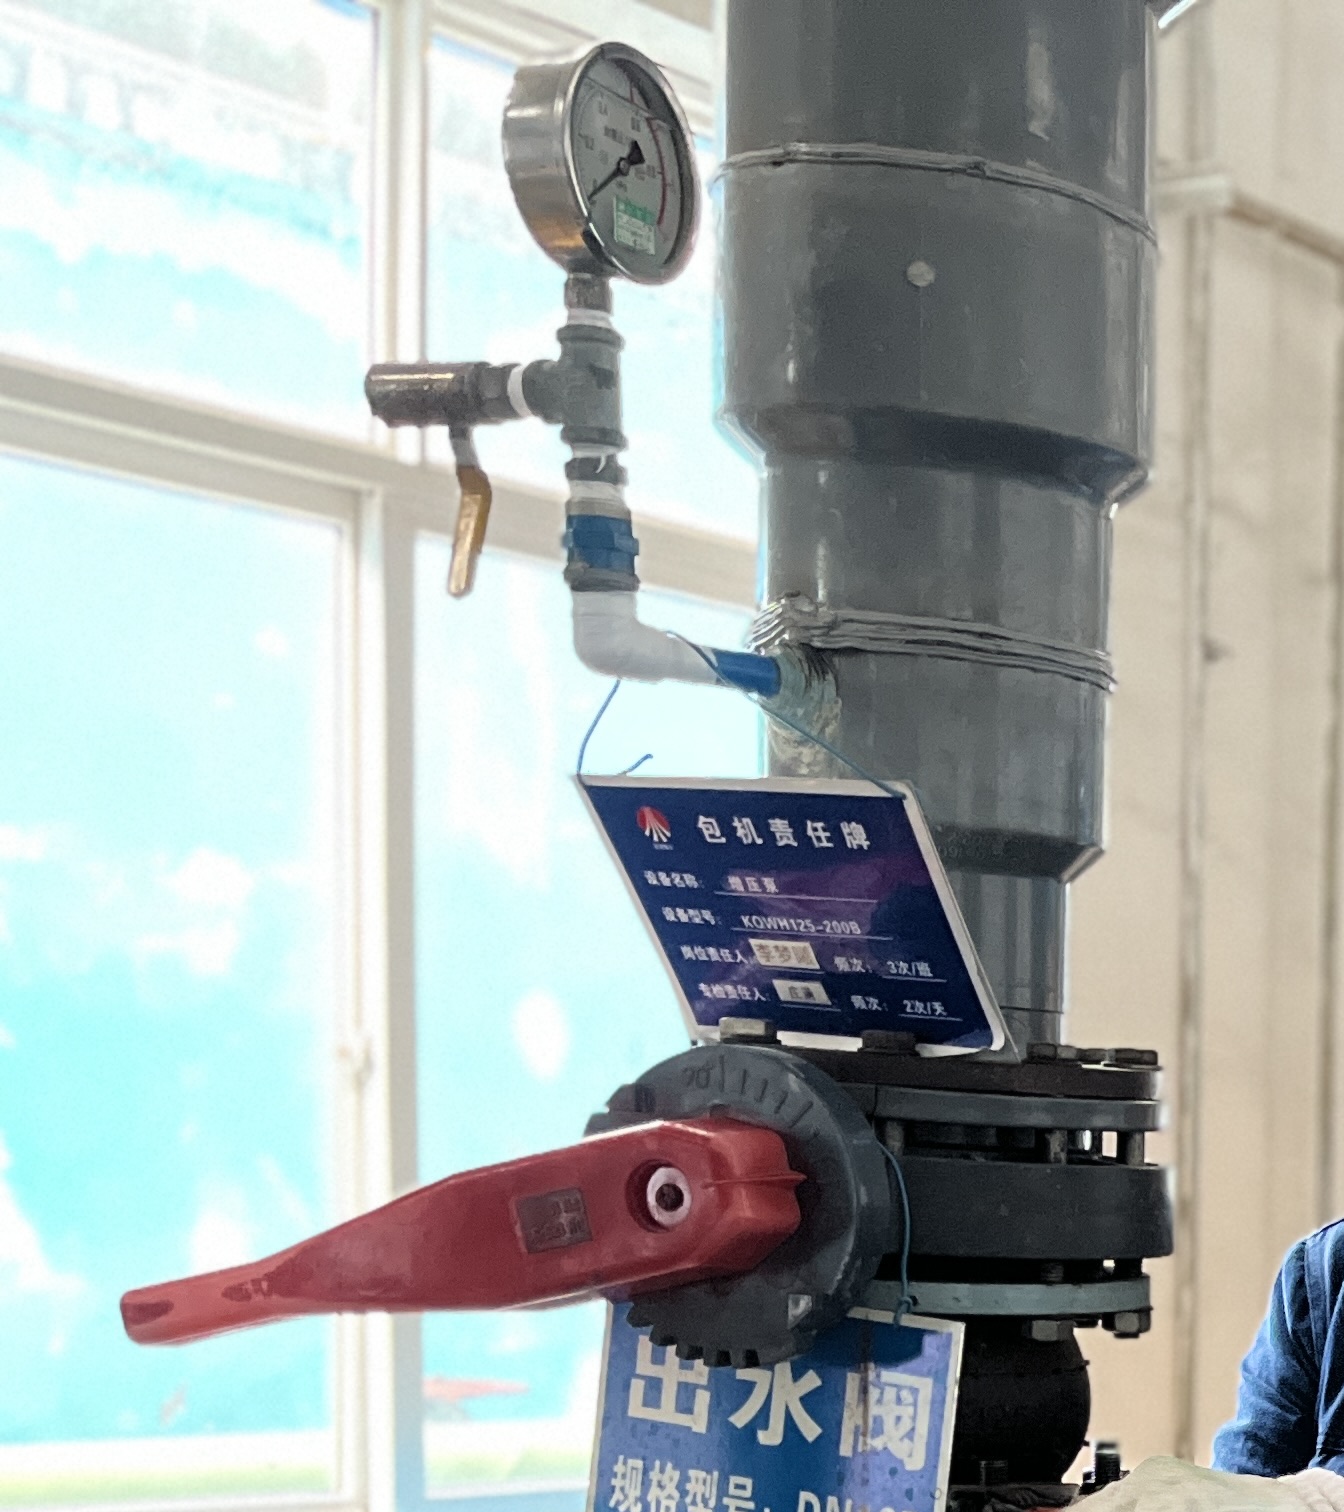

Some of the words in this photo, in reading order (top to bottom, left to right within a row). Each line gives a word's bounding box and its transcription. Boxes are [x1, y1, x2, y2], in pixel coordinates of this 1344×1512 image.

[697, 815, 872, 851] 包机责任牌
[627, 1336, 934, 1471] 出水阀
